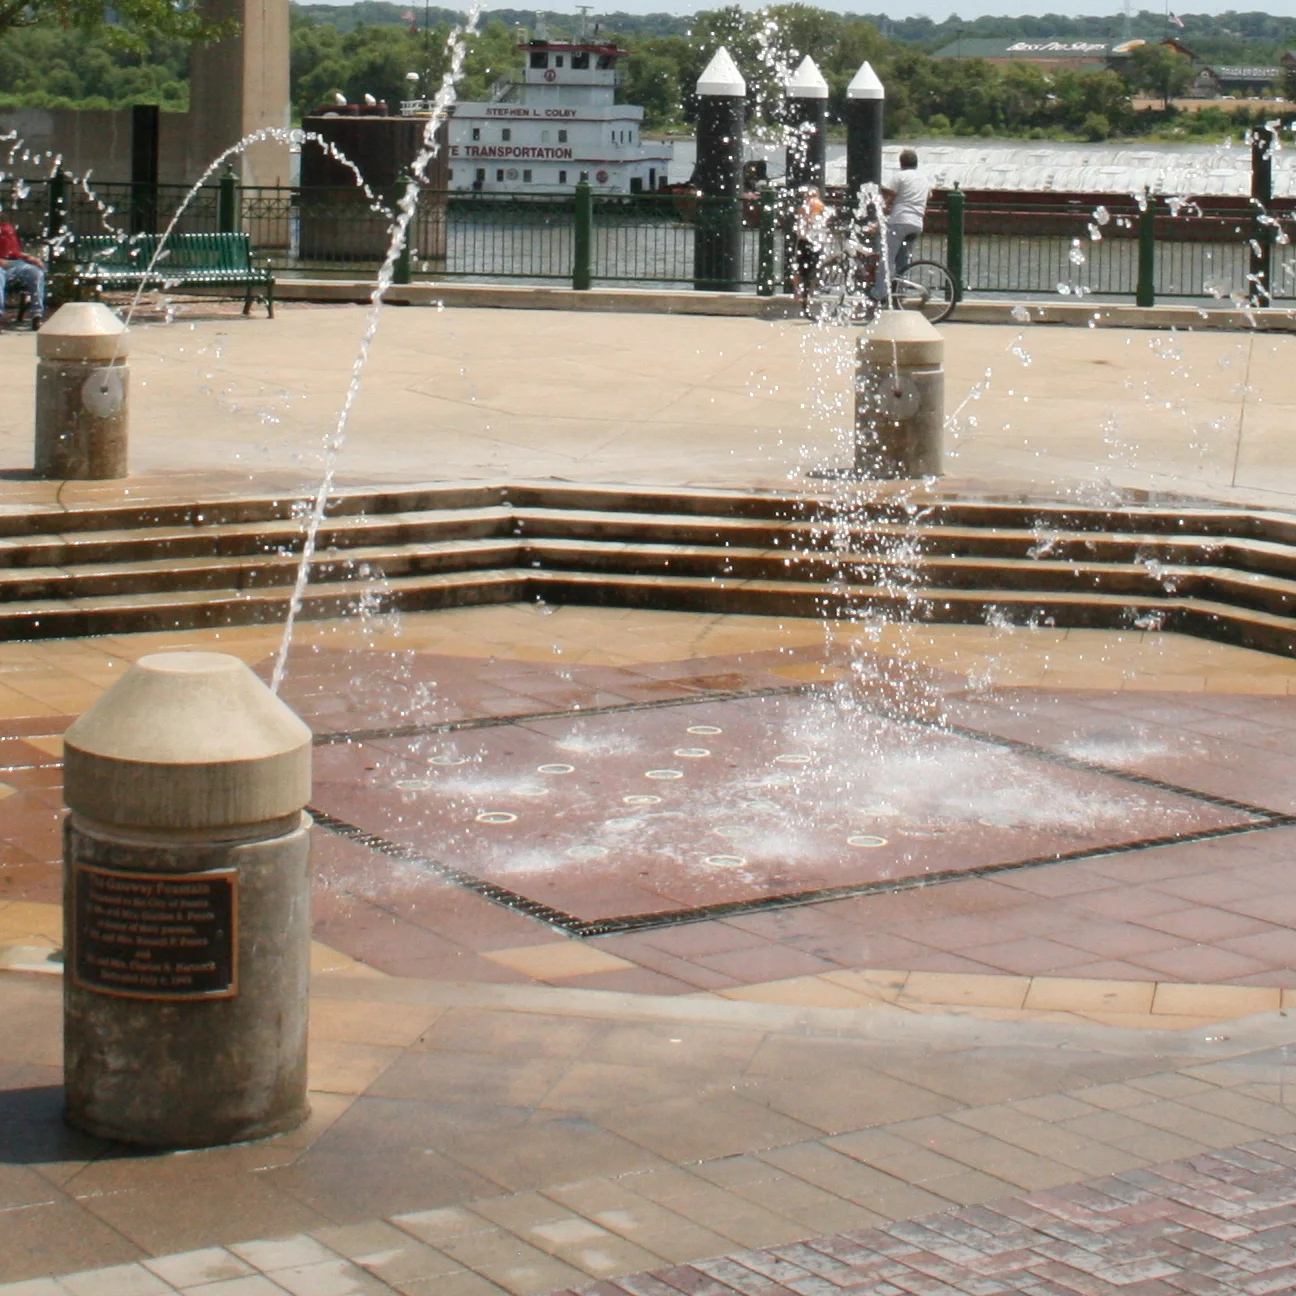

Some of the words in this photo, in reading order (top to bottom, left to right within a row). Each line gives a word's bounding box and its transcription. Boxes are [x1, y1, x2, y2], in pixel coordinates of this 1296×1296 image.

[486, 108, 529, 116] STEPHEN
[545, 109, 576, 117] COLBY
[465, 145, 572, 159] TRANSPORTATION
